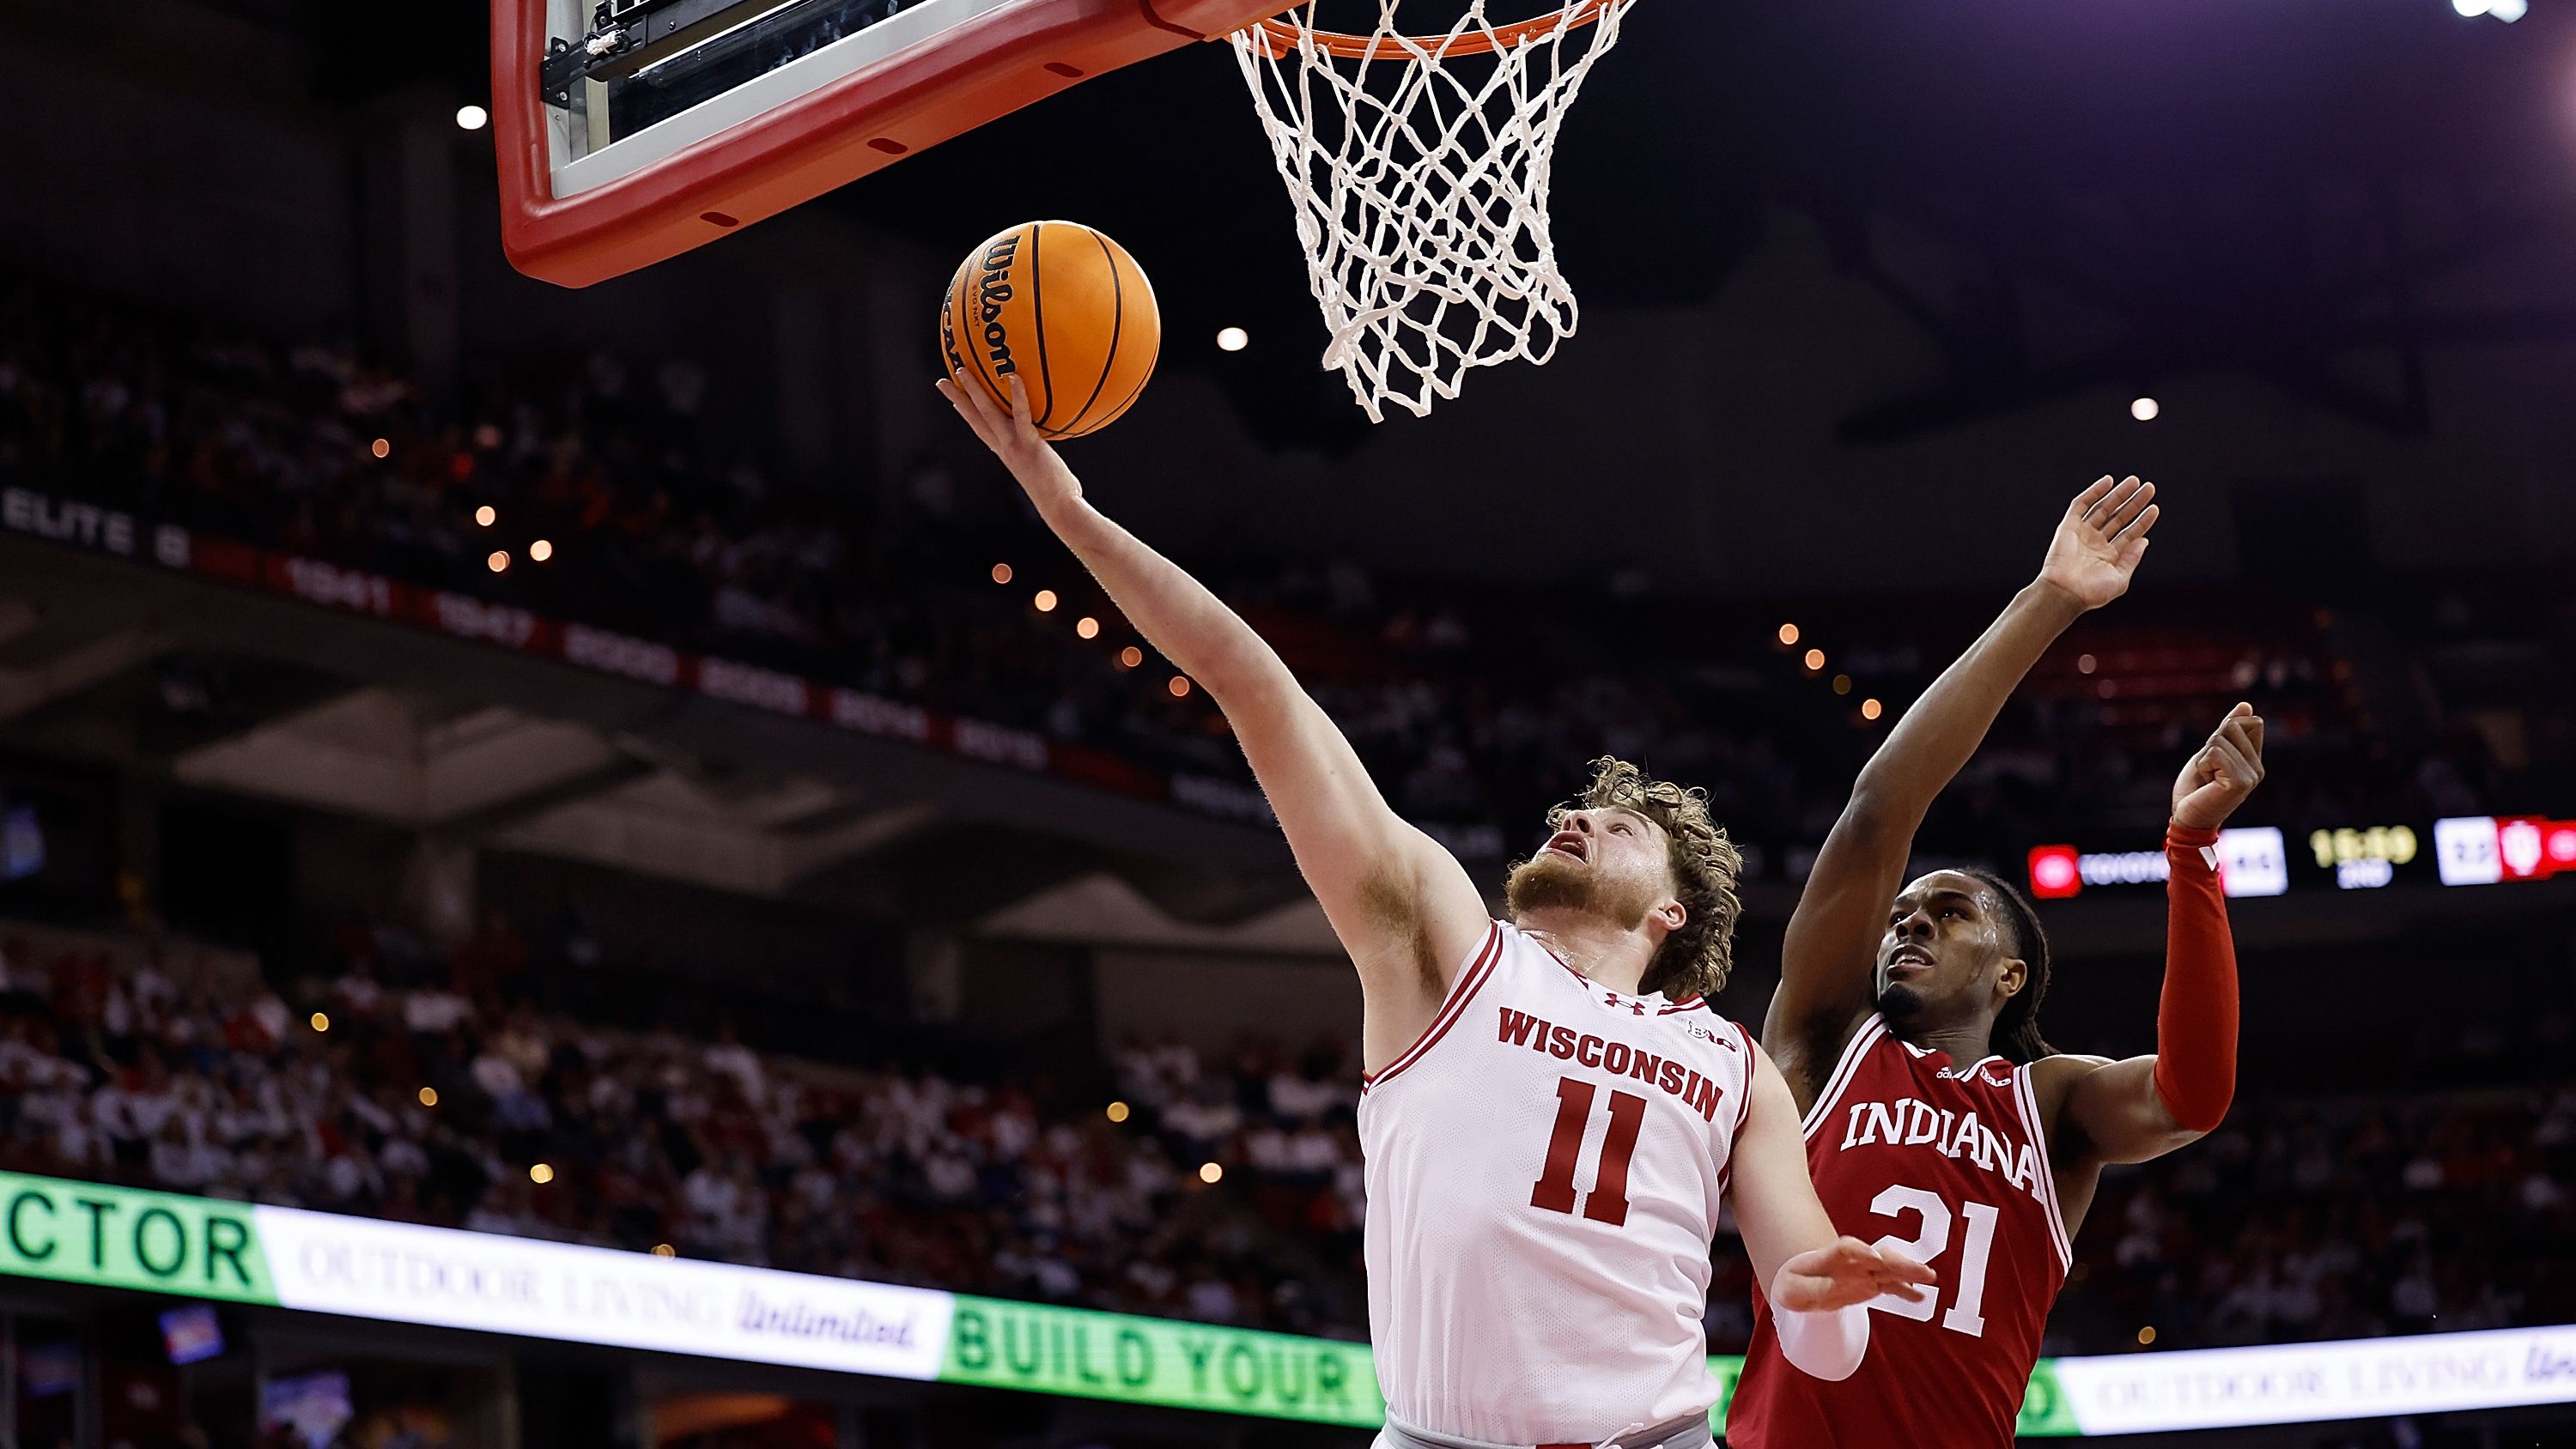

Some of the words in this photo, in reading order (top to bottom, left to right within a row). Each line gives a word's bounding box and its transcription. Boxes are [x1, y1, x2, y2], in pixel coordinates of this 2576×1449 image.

[980, 235, 1023, 378] Wilson
[3, 487, 135, 555] ELITE
[1498, 1006, 1723, 1124] WISCONSIN
[1529, 1076, 1648, 1228] 11
[1840, 1097, 2046, 1204] INDIANA
[8, 1189, 252, 1288] CTOR
[298, 1234, 544, 1308] OUTDOOR
[562, 1264, 723, 1331] LIVING
[1867, 1184, 2000, 1338] 21
[953, 1308, 1156, 1388] BUILD
[1180, 1337, 1353, 1408] YOUR
[2096, 1363, 2328, 1412] OUTDOOR
